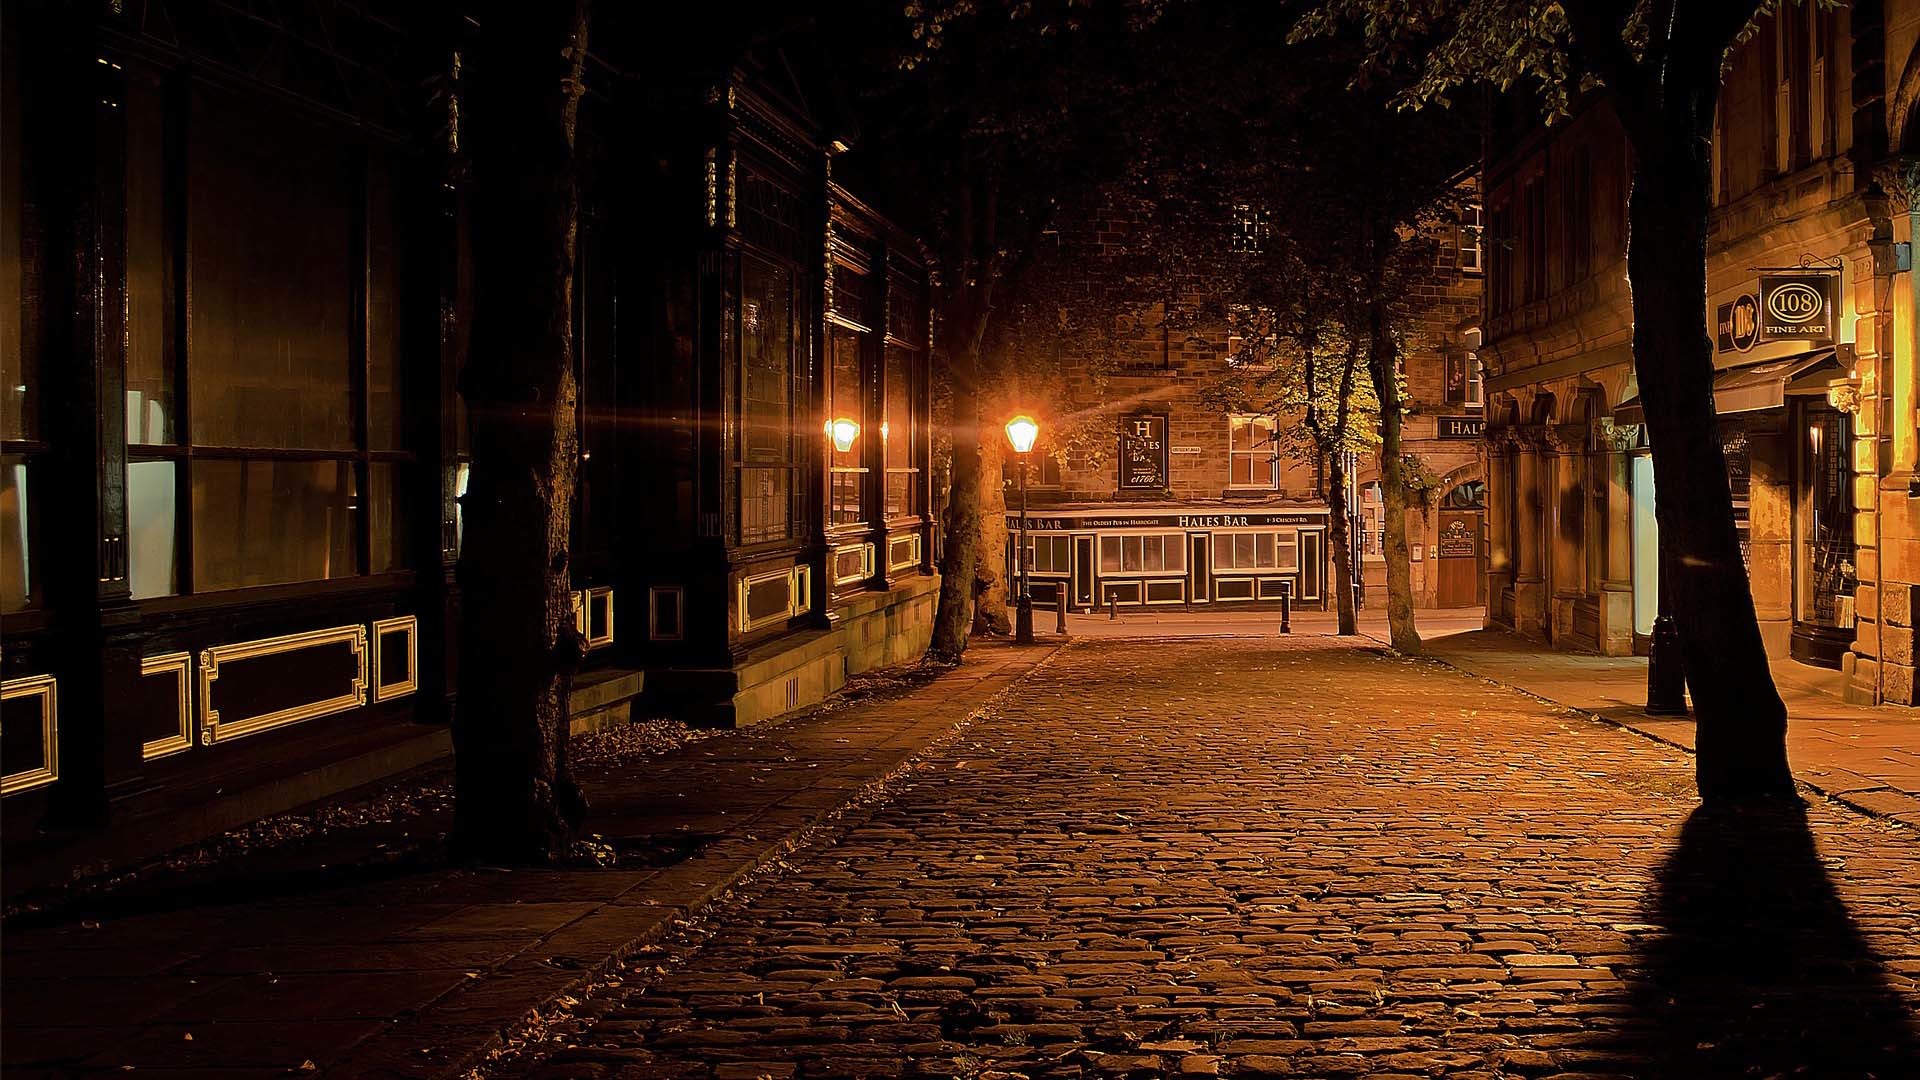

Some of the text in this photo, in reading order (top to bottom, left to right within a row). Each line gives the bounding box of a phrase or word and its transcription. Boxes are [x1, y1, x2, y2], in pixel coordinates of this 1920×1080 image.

[1779, 294, 1812, 312] 108
[1720, 321, 1731, 336] FINE
[1766, 326, 1797, 334] FINE
[1133, 421, 1152, 438] H
[1127, 440, 1160, 450] HES
[1133, 451, 1150, 462] BA
[1006, 518, 1063, 530] ALS BAR
[1179, 515, 1249, 527] HALES BAR
